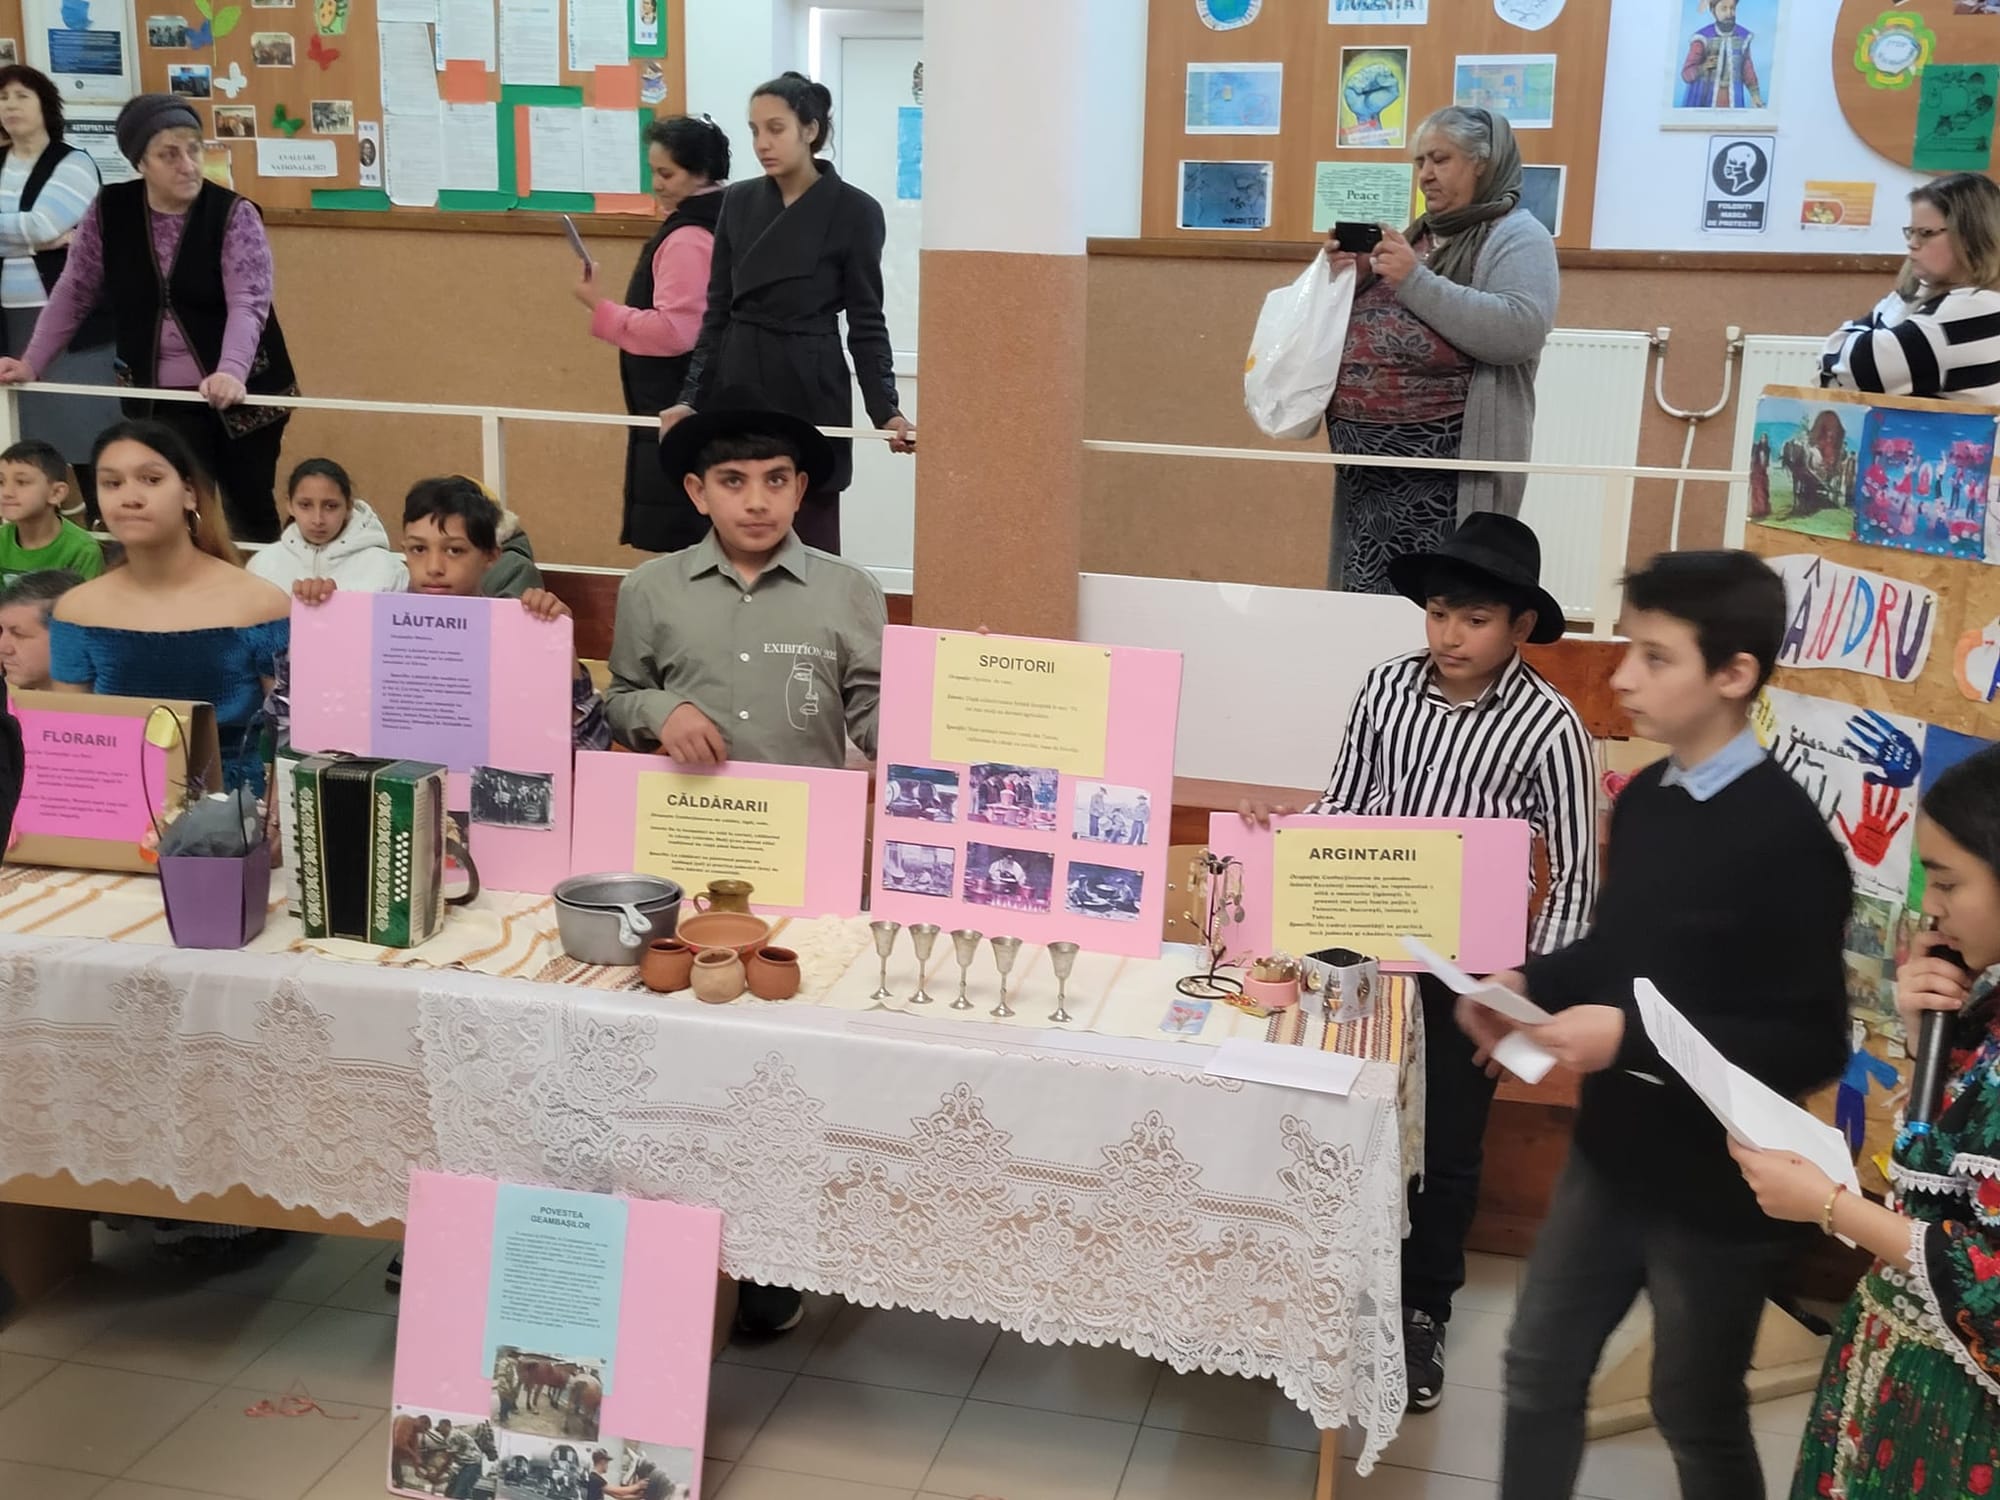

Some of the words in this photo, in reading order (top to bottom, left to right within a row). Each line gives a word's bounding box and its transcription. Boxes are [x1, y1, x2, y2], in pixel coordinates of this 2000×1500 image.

[1346, 189, 1381, 200] Peace
[392, 611, 468, 631] LĂUTARII
[1780, 555, 1933, 680] ÂNDRU
[763, 642, 822, 656] EXIBITION
[979, 654, 1056, 674] SPOITORII
[42, 730, 118, 748] FLORARII
[667, 792, 769, 813] CĂLDĂRARII
[1309, 847, 1416, 861] ARGINTARII
[540, 1206, 584, 1219] POVESTEA
